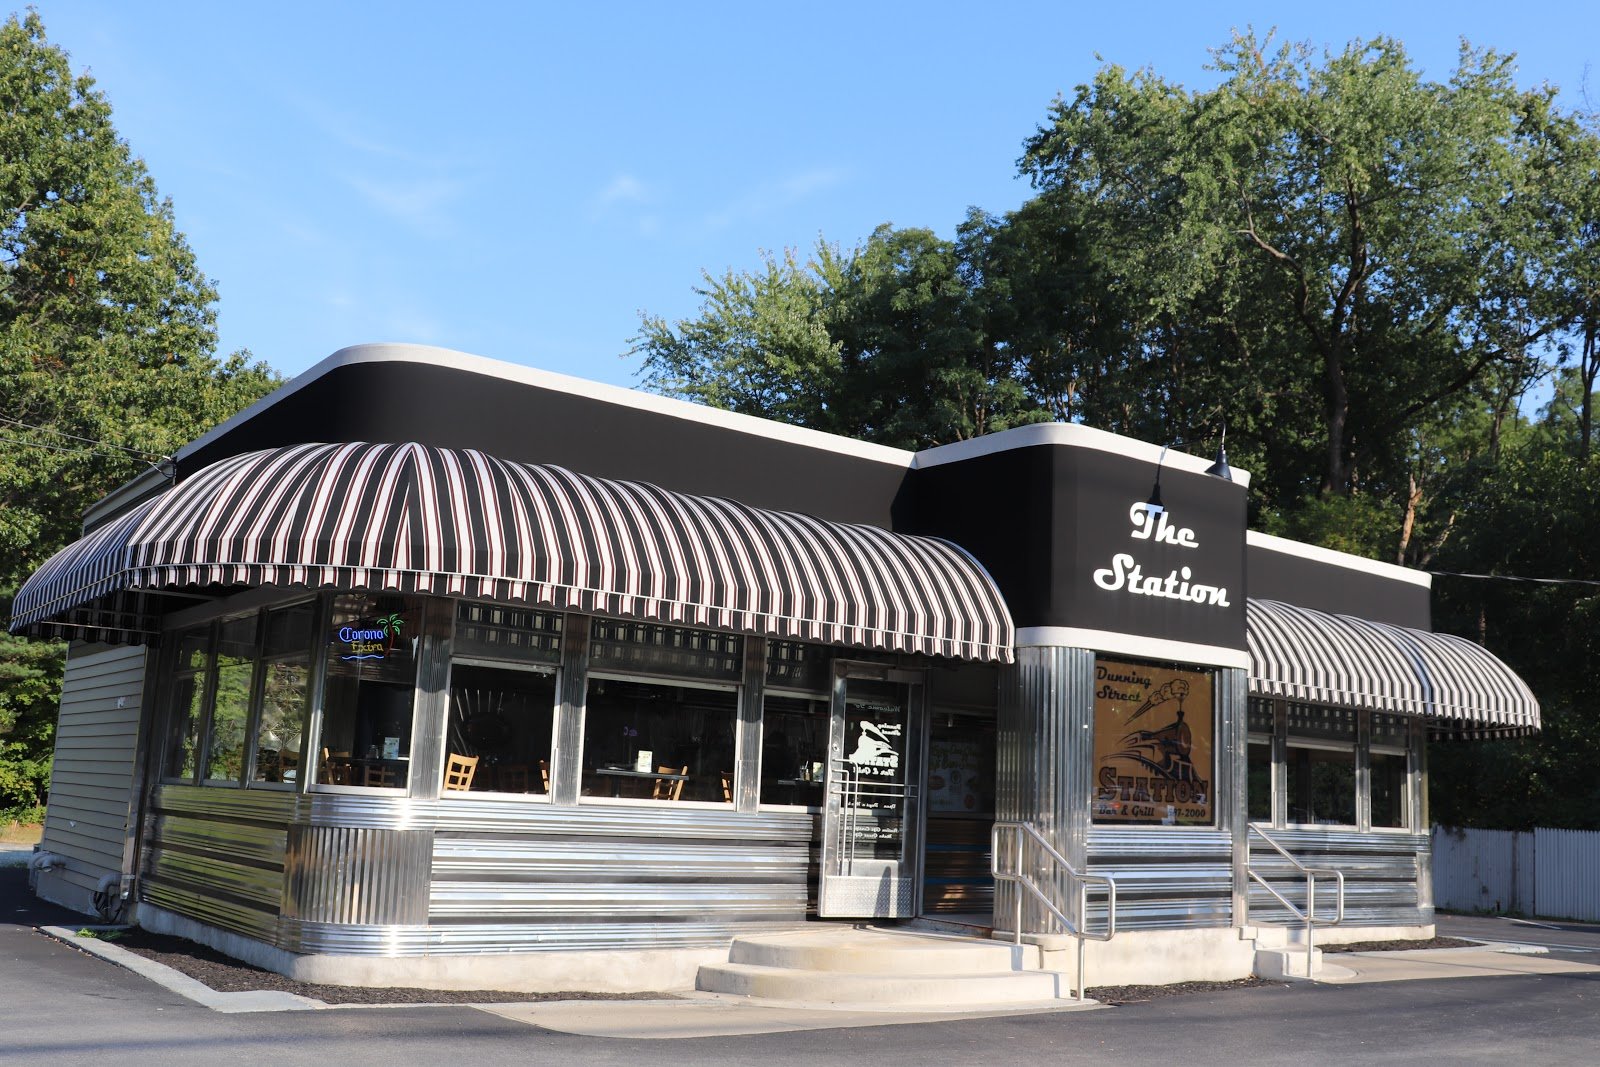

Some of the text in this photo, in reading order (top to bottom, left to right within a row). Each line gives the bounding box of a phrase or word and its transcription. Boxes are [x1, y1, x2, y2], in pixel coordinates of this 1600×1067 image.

[1129, 501, 1199, 548] The
[1093, 553, 1231, 607] Station
[339, 627, 384, 642] Corona
[351, 640, 384, 653] Extra
[1096, 666, 1152, 690] Dunning
[1096, 685, 1142, 702] Street
[1098, 766, 1208, 804] STATION
[1121, 804, 1129, 816] &
[1131, 805, 1155, 817] Grill
